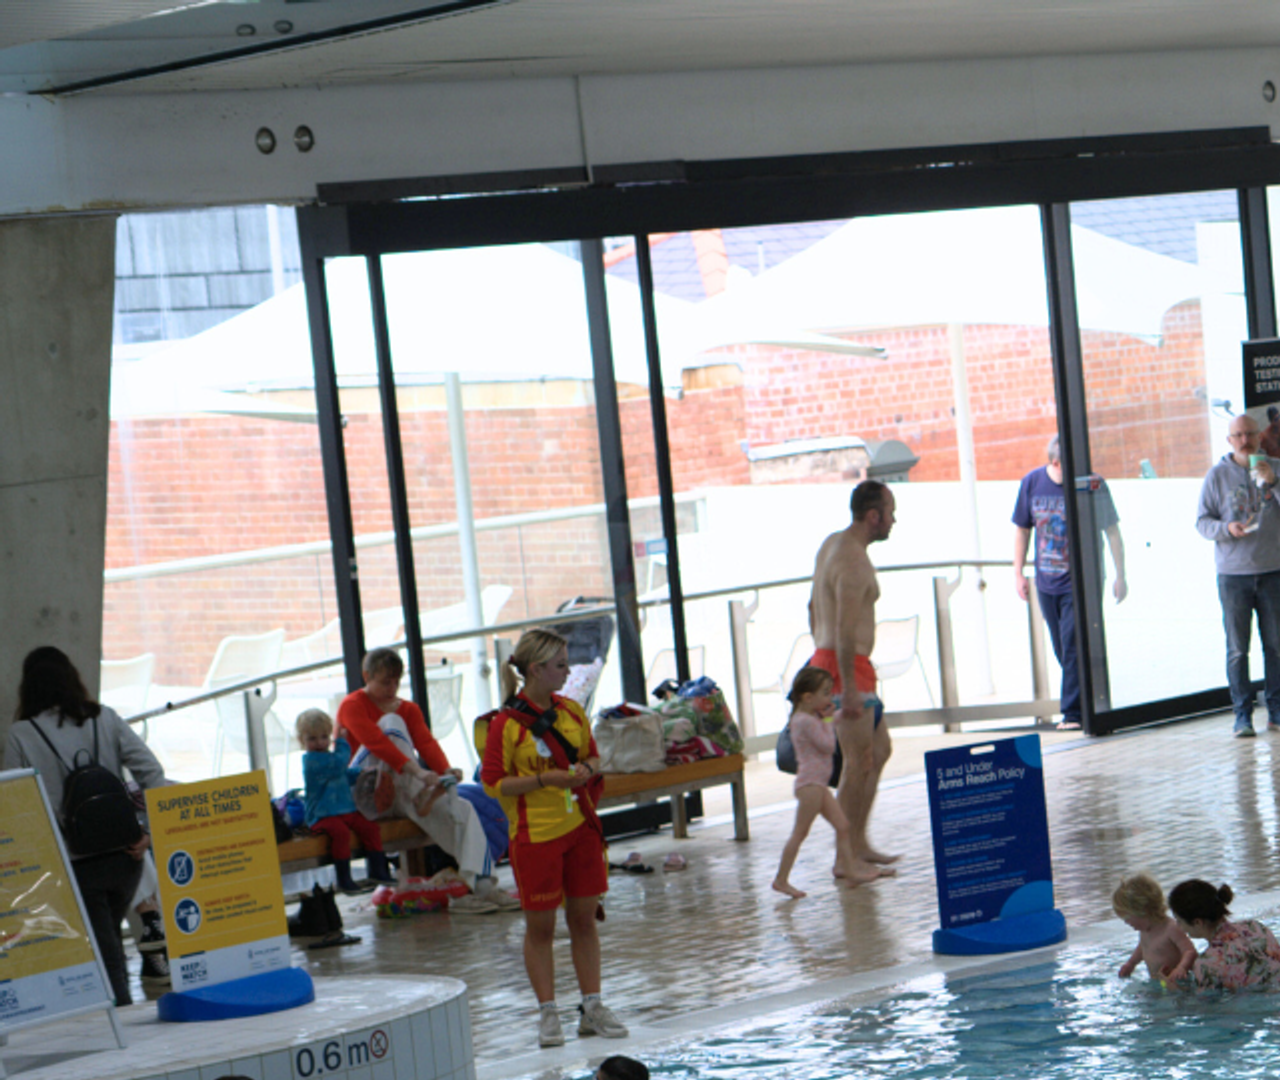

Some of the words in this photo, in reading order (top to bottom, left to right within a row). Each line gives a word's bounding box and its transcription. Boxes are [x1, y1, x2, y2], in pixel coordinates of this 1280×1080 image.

[937, 768, 944, 780] 5
[946, 764, 963, 777] and
[964, 761, 993, 775] Under
[938, 777, 965, 791] Arms
[966, 770, 997, 786] Reach
[998, 766, 1025, 781] Policy
[157, 792, 209, 813] SUPERVISE
[211, 784, 259, 803] CHILDREN
[180, 808, 191, 821] AT
[194, 805, 211, 818] ALL
[212, 800, 242, 816] TIMES
[296, 1041, 342, 1078] 0.6
[348, 1041, 370, 1067] m
